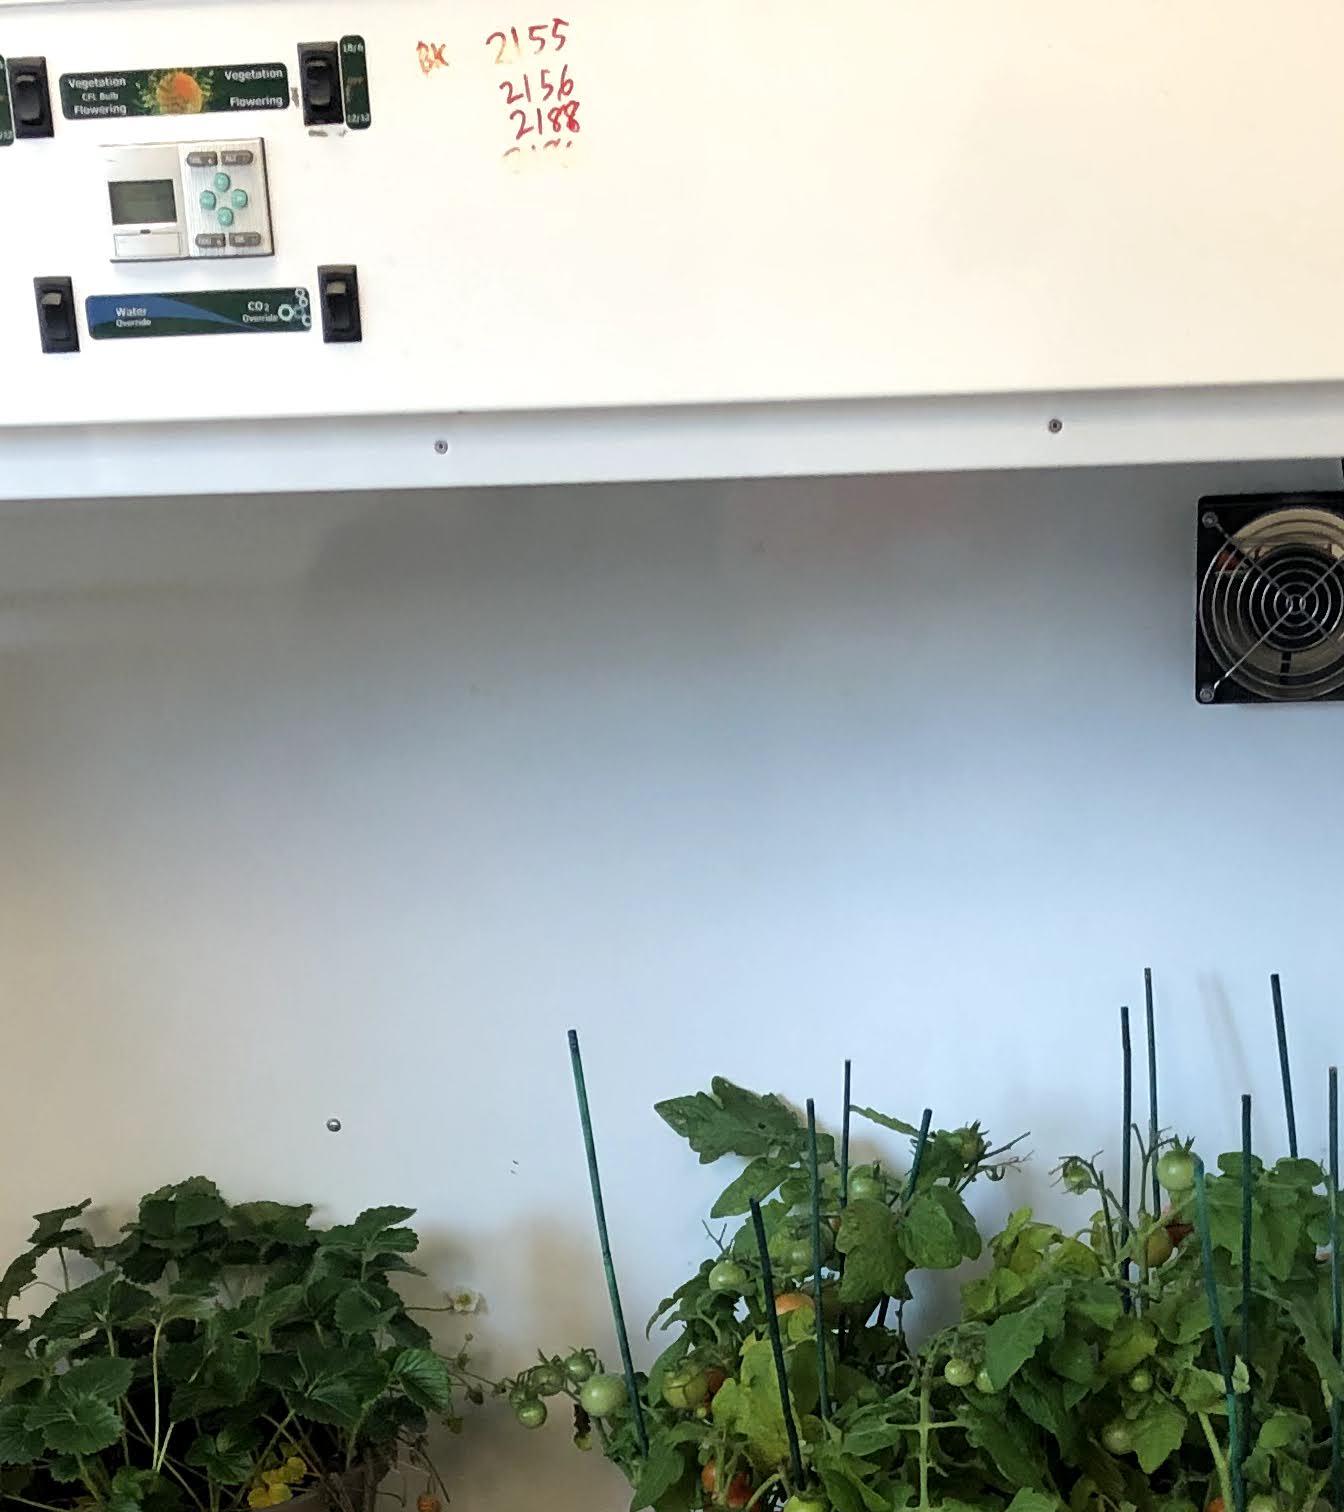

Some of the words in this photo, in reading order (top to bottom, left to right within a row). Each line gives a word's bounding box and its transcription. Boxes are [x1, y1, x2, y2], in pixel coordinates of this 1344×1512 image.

[485, 17, 570, 65] 2155
[224, 68, 284, 83] Vegetation
[68, 77, 127, 91] Vegetation
[499, 64, 574, 105] 2156
[230, 95, 284, 109] Flowering
[73, 103, 127, 116] Flowering
[509, 100, 581, 140] 2188
[115, 306, 148, 318] Water
[242, 313, 279, 323] Override
[115, 318, 152, 328] Override
